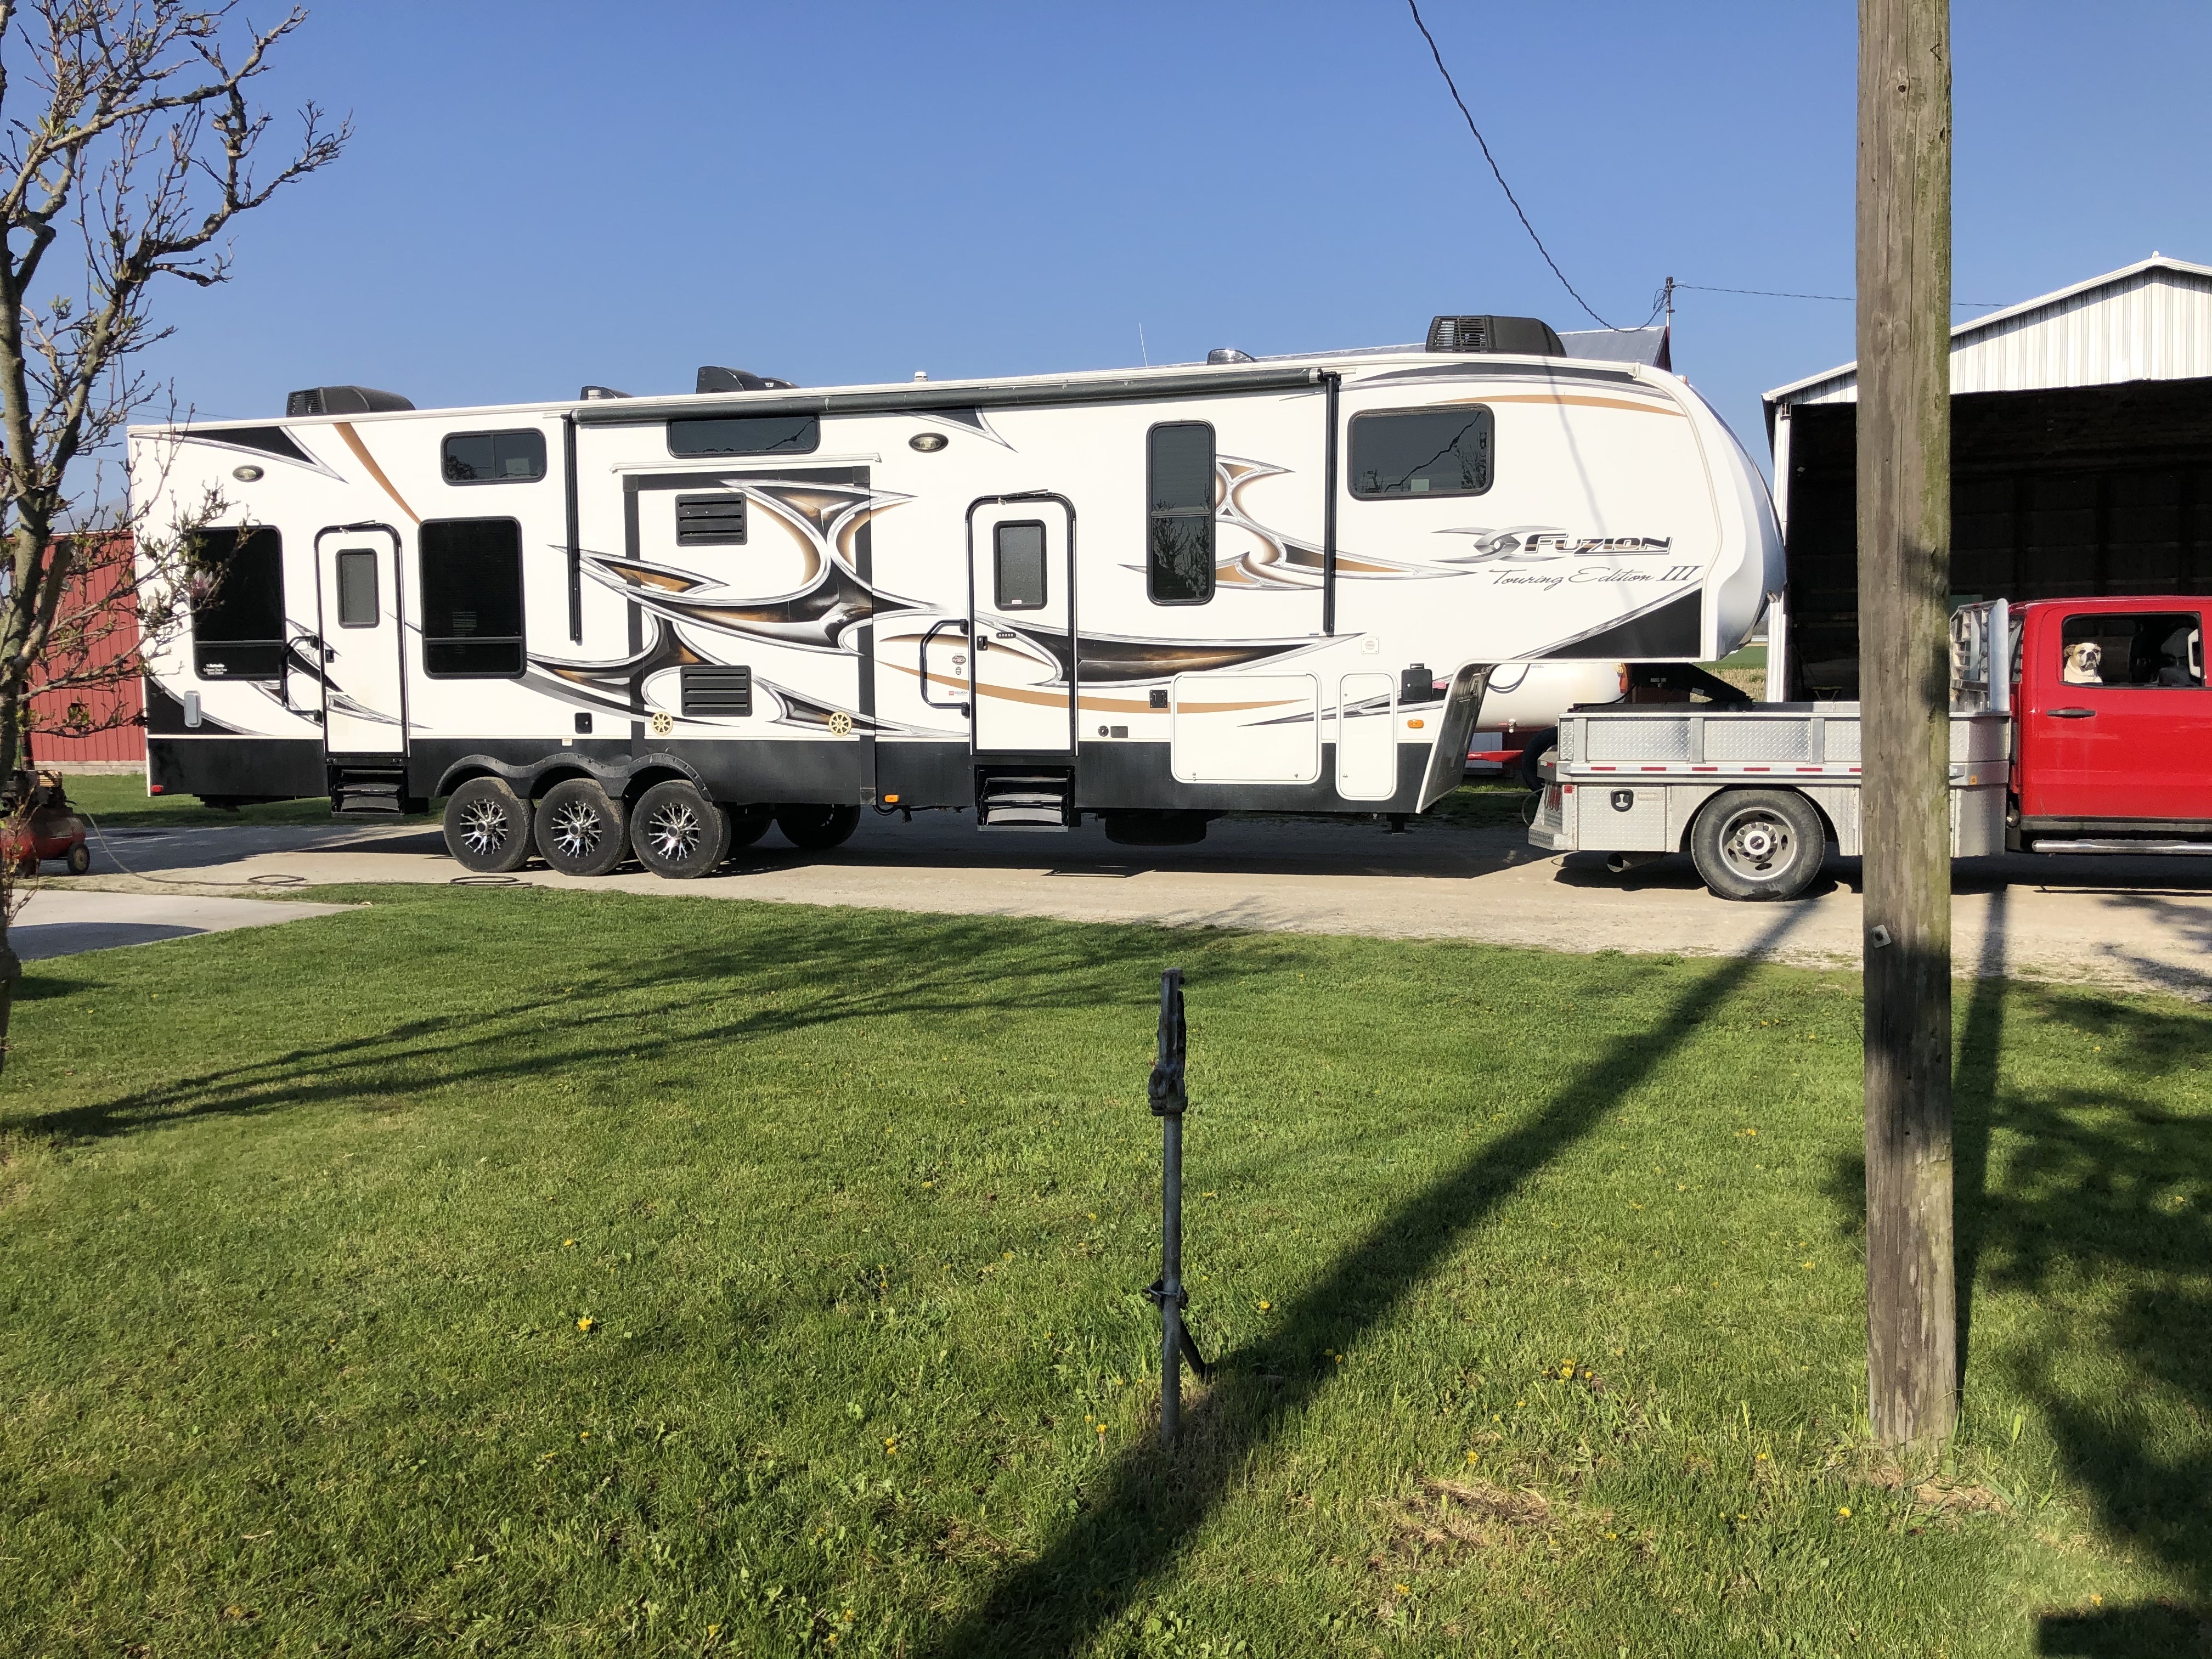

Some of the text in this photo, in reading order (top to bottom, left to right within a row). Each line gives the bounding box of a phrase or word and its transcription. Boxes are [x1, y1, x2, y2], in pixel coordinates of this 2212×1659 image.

[1524, 533, 1673, 557] FUZION
[1488, 565, 1704, 591] Touring Edition III
